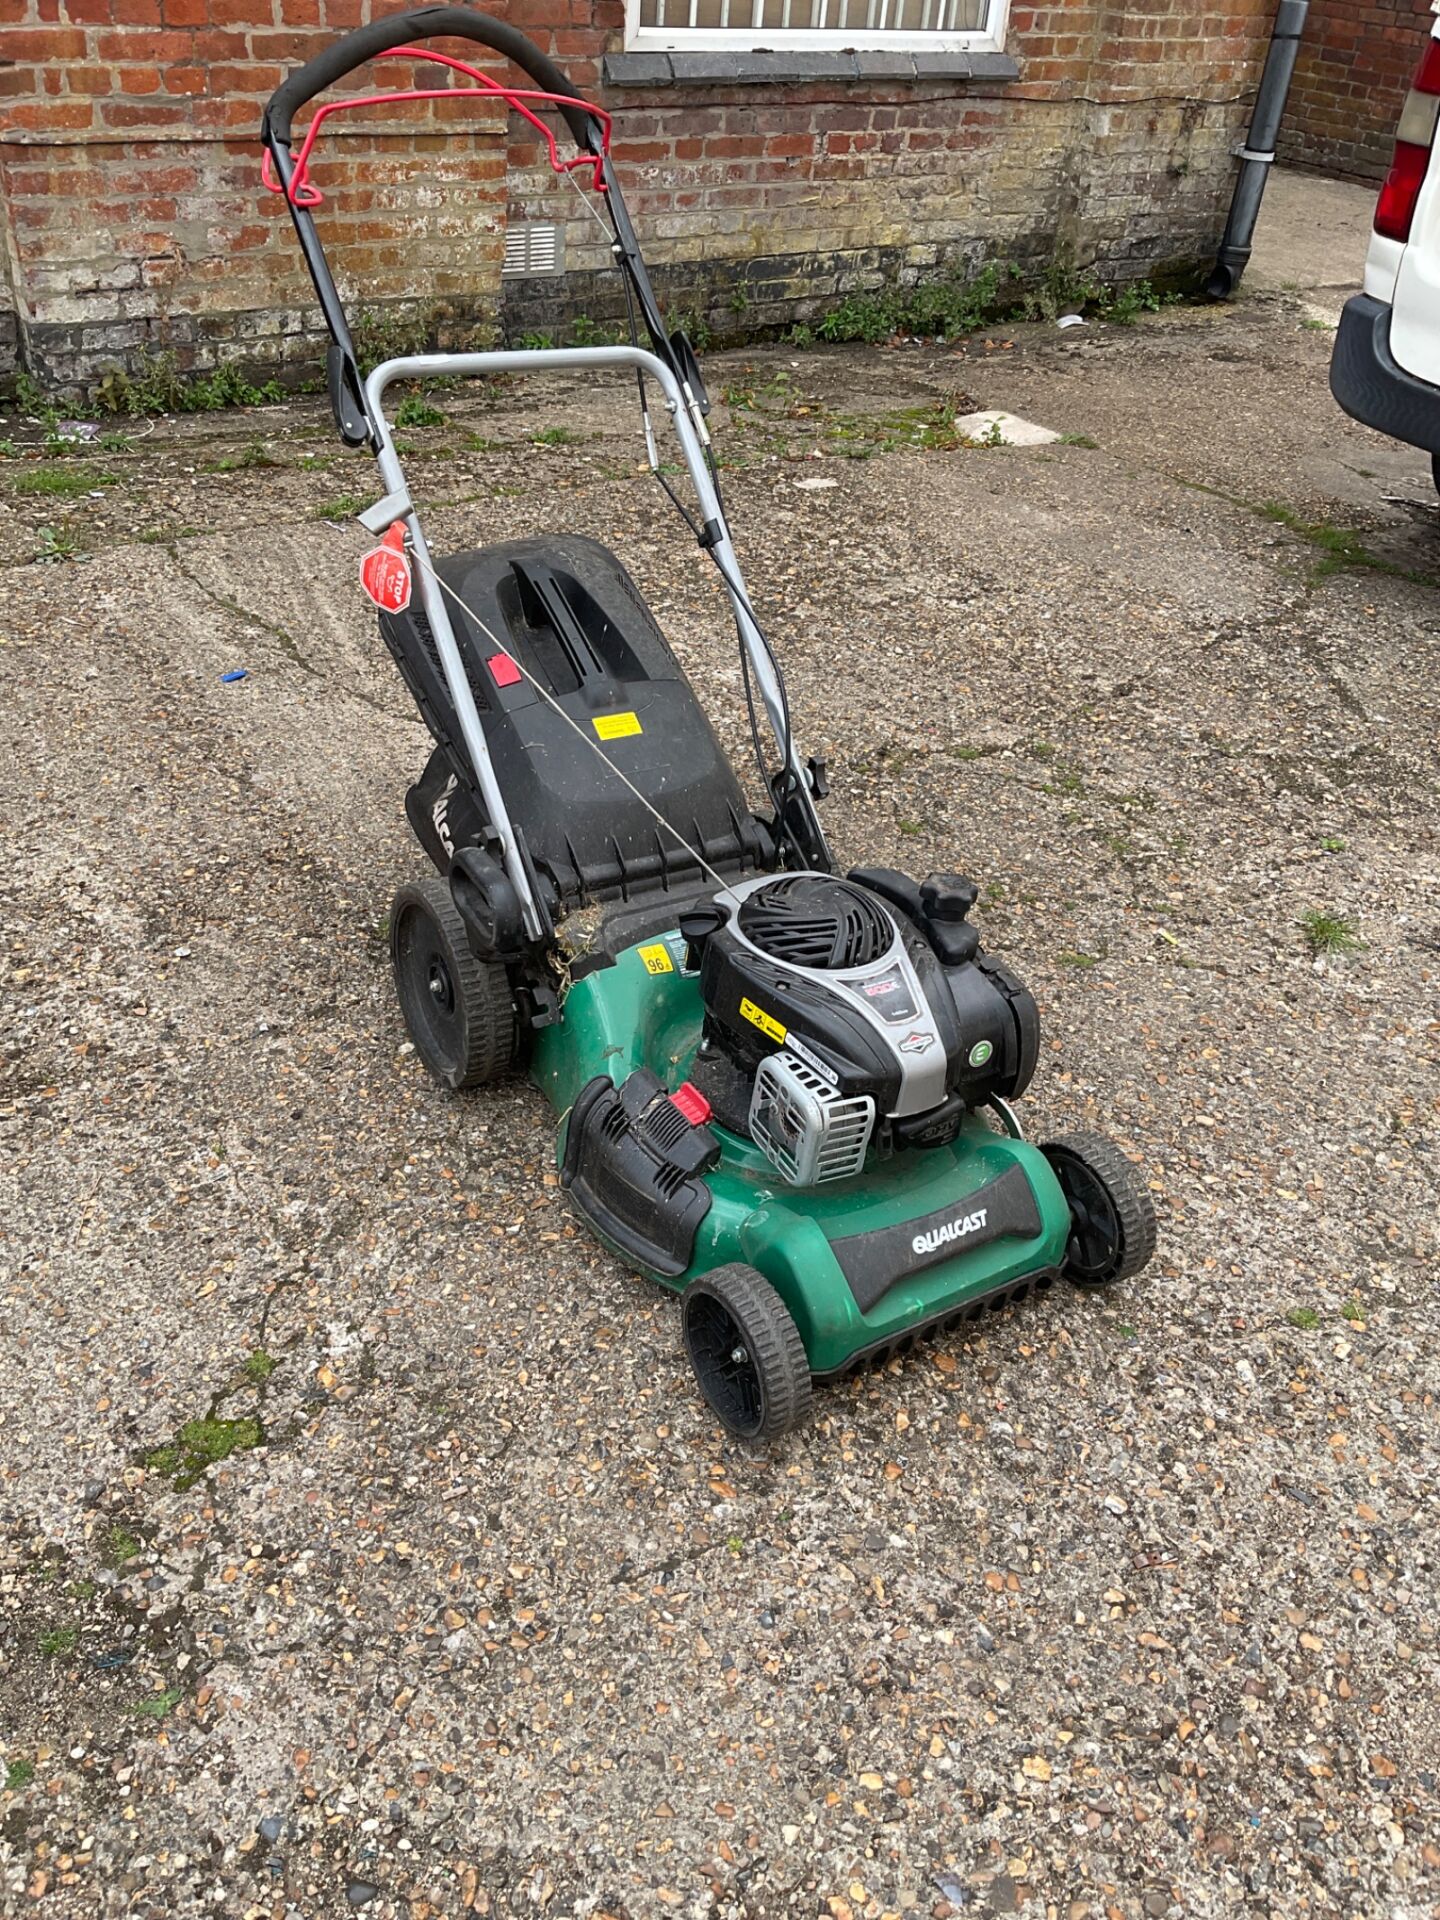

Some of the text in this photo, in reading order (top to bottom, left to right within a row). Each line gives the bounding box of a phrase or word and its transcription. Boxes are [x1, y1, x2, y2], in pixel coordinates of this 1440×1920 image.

[393, 570, 406, 604] STOP
[647, 957, 665, 972] 96
[912, 1208, 988, 1255] QUALCAST
